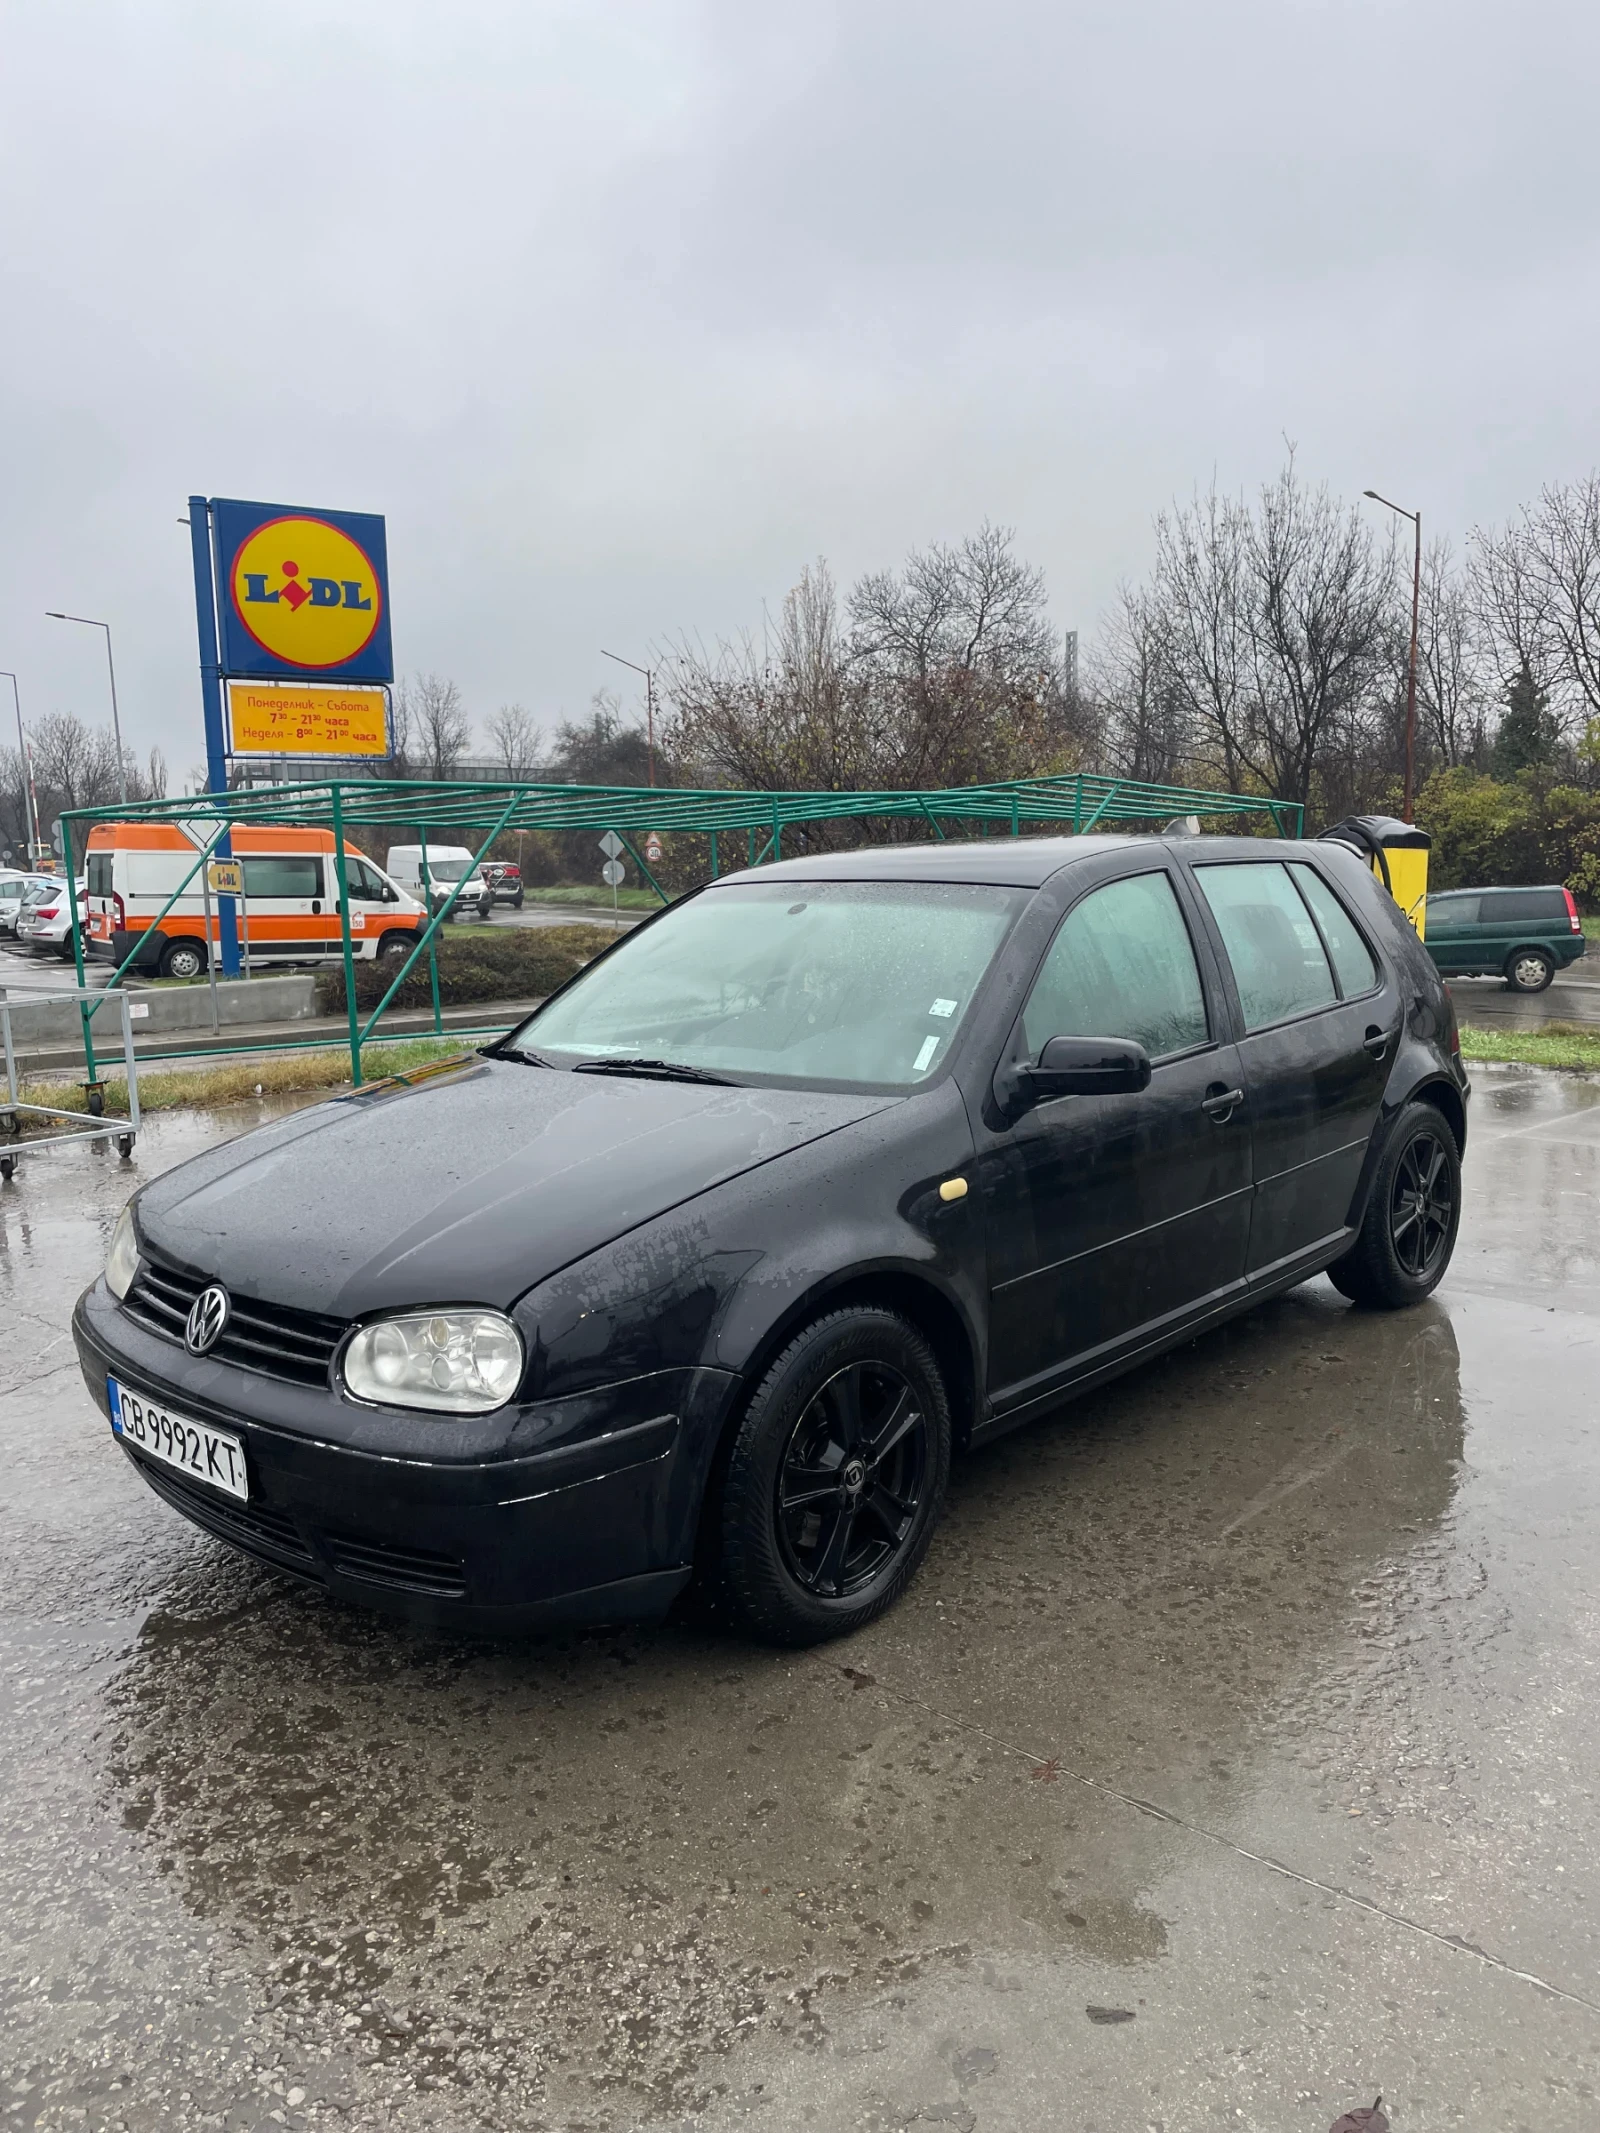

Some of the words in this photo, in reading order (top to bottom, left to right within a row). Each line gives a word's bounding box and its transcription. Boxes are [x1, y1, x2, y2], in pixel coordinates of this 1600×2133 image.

[247, 697, 314, 710] Понеделник
[327, 700, 369, 711] Събота
[325, 718, 350, 726] часа
[243, 727, 284, 740] Неделя
[352, 733, 377, 741] часа
[352, 920, 364, 928] 150
